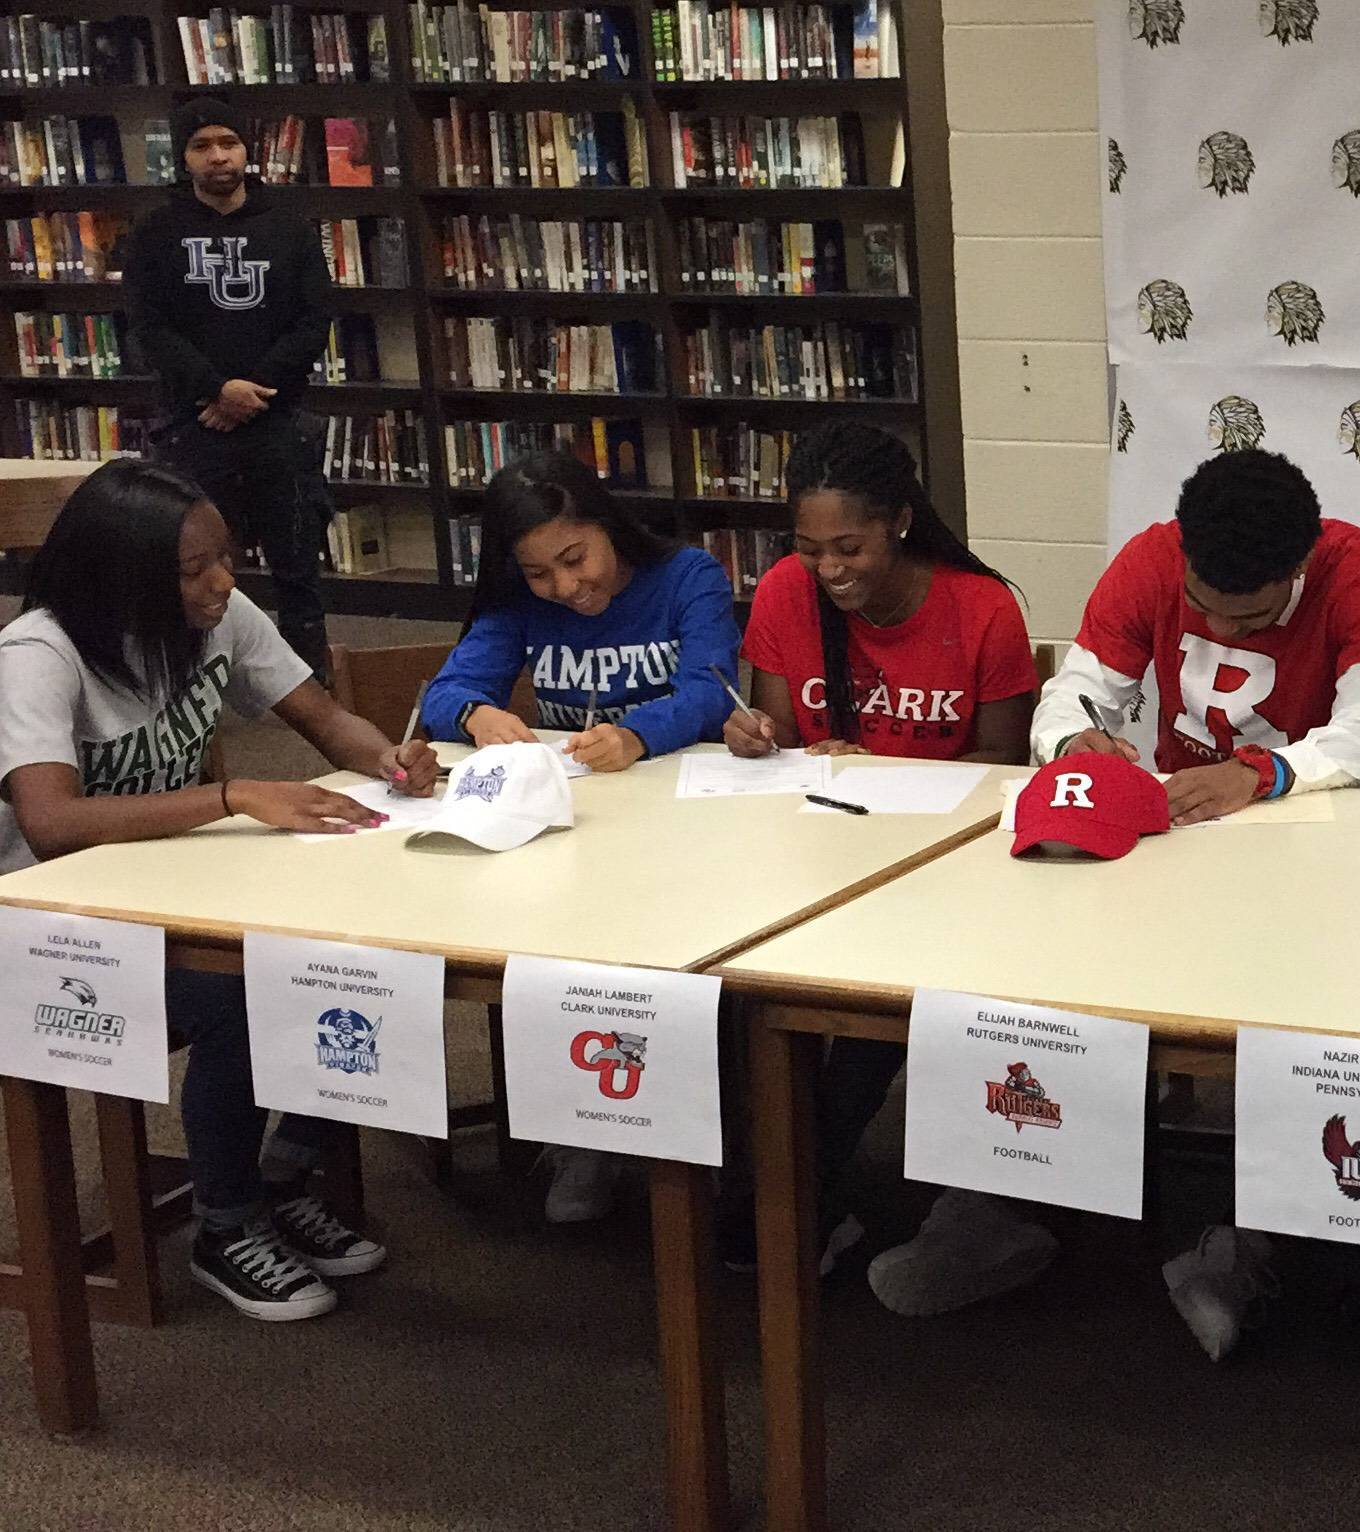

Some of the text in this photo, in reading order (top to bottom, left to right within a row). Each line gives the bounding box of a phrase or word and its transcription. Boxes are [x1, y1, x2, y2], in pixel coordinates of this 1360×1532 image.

[181, 237, 270, 310] HU
[527, 639, 680, 692] AMPTON
[801, 677, 964, 722] CARK
[1173, 632, 1289, 750] R
[812, 712, 955, 739] SCCER
[1050, 772, 1095, 809] R
[48, 935, 101, 949] LELA ALLEN
[29, 947, 120, 967] WAGNER UNIVERSITY
[307, 963, 377, 980] AYANA GARVIN
[291, 976, 394, 998] HAMPTON UNIVERSITY
[565, 986, 653, 1004] JANIAH LAMBERT
[35, 1003, 125, 1037] WAGNER
[561, 1002, 657, 1021] CLARK UNIVERSITY
[977, 1011, 1080, 1037] ELIJAH BARNWELL
[967, 1027, 1088, 1055] RUTGERS UNIVERSITY
[318, 1046, 378, 1071] HAMPTON
[570, 1030, 645, 1100] CU
[1324, 1050, 1359, 1064] NAZIR
[1292, 1065, 1340, 1081] INDIANA
[317, 1088, 388, 1107] WOMEN'S SOCCER
[576, 1109, 652, 1128] WOMEN'S SOCCER
[993, 1146, 1052, 1165] FOOTBALL
